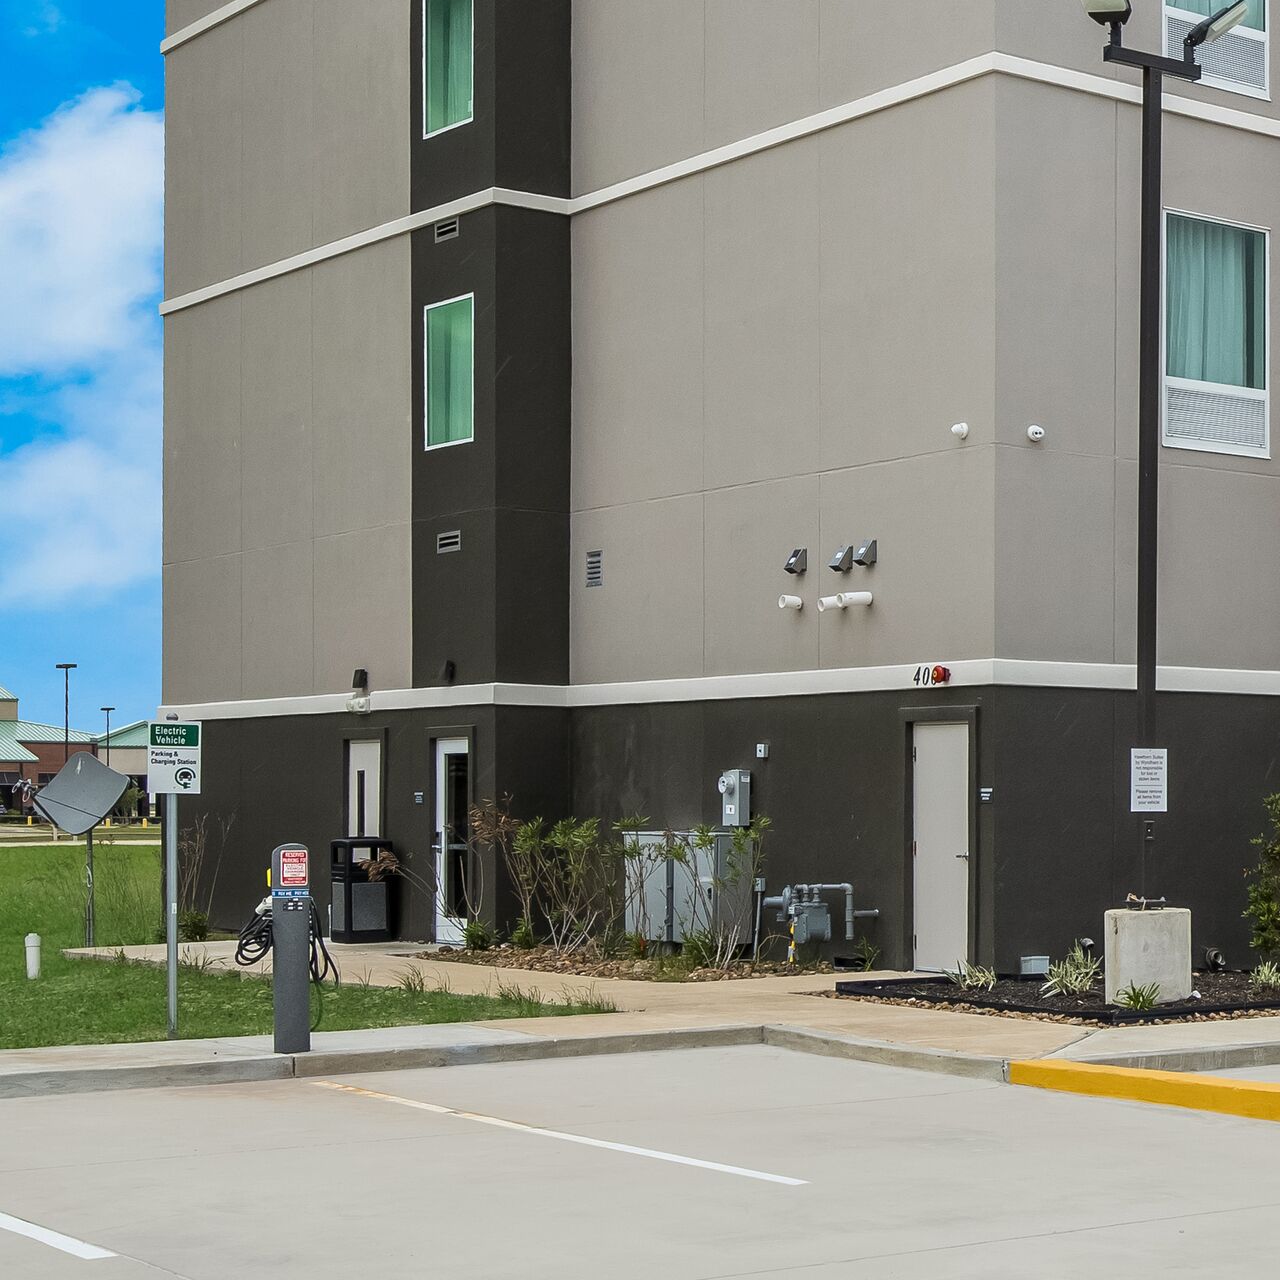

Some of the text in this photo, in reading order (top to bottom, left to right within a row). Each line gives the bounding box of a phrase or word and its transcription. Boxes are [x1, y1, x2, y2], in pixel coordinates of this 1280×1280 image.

[155, 726, 187, 735] Electric
[155, 735, 186, 745] Vehicle
[151, 758, 176, 766] Charging
